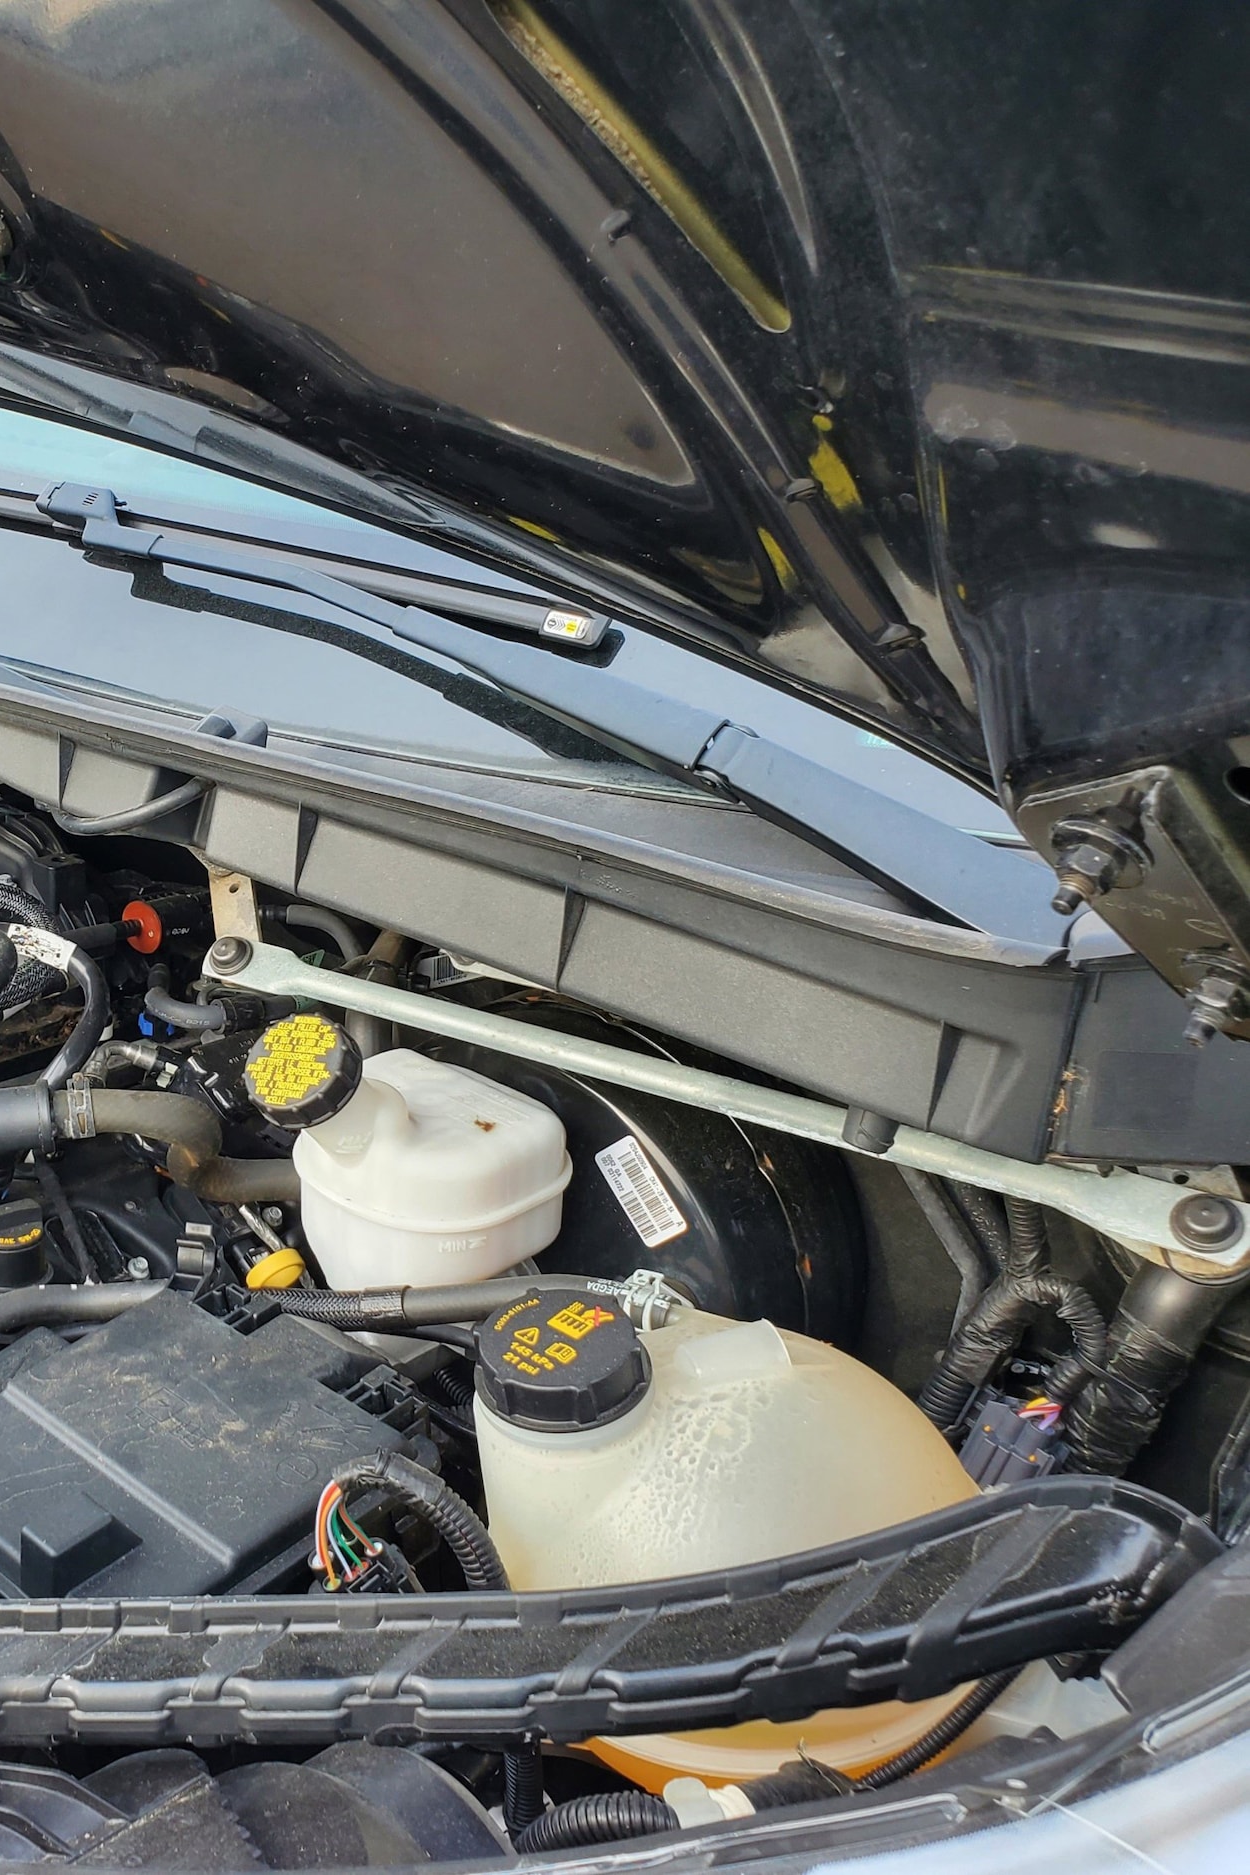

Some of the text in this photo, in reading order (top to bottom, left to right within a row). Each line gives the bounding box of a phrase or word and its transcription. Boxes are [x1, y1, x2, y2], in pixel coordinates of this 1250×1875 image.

[296, 1023, 317, 1032] FILLER
[318, 1024, 331, 1033] CAP
[501, 1350, 541, 1378] 21 psi
[508, 1340, 557, 1372] 145 kPa
